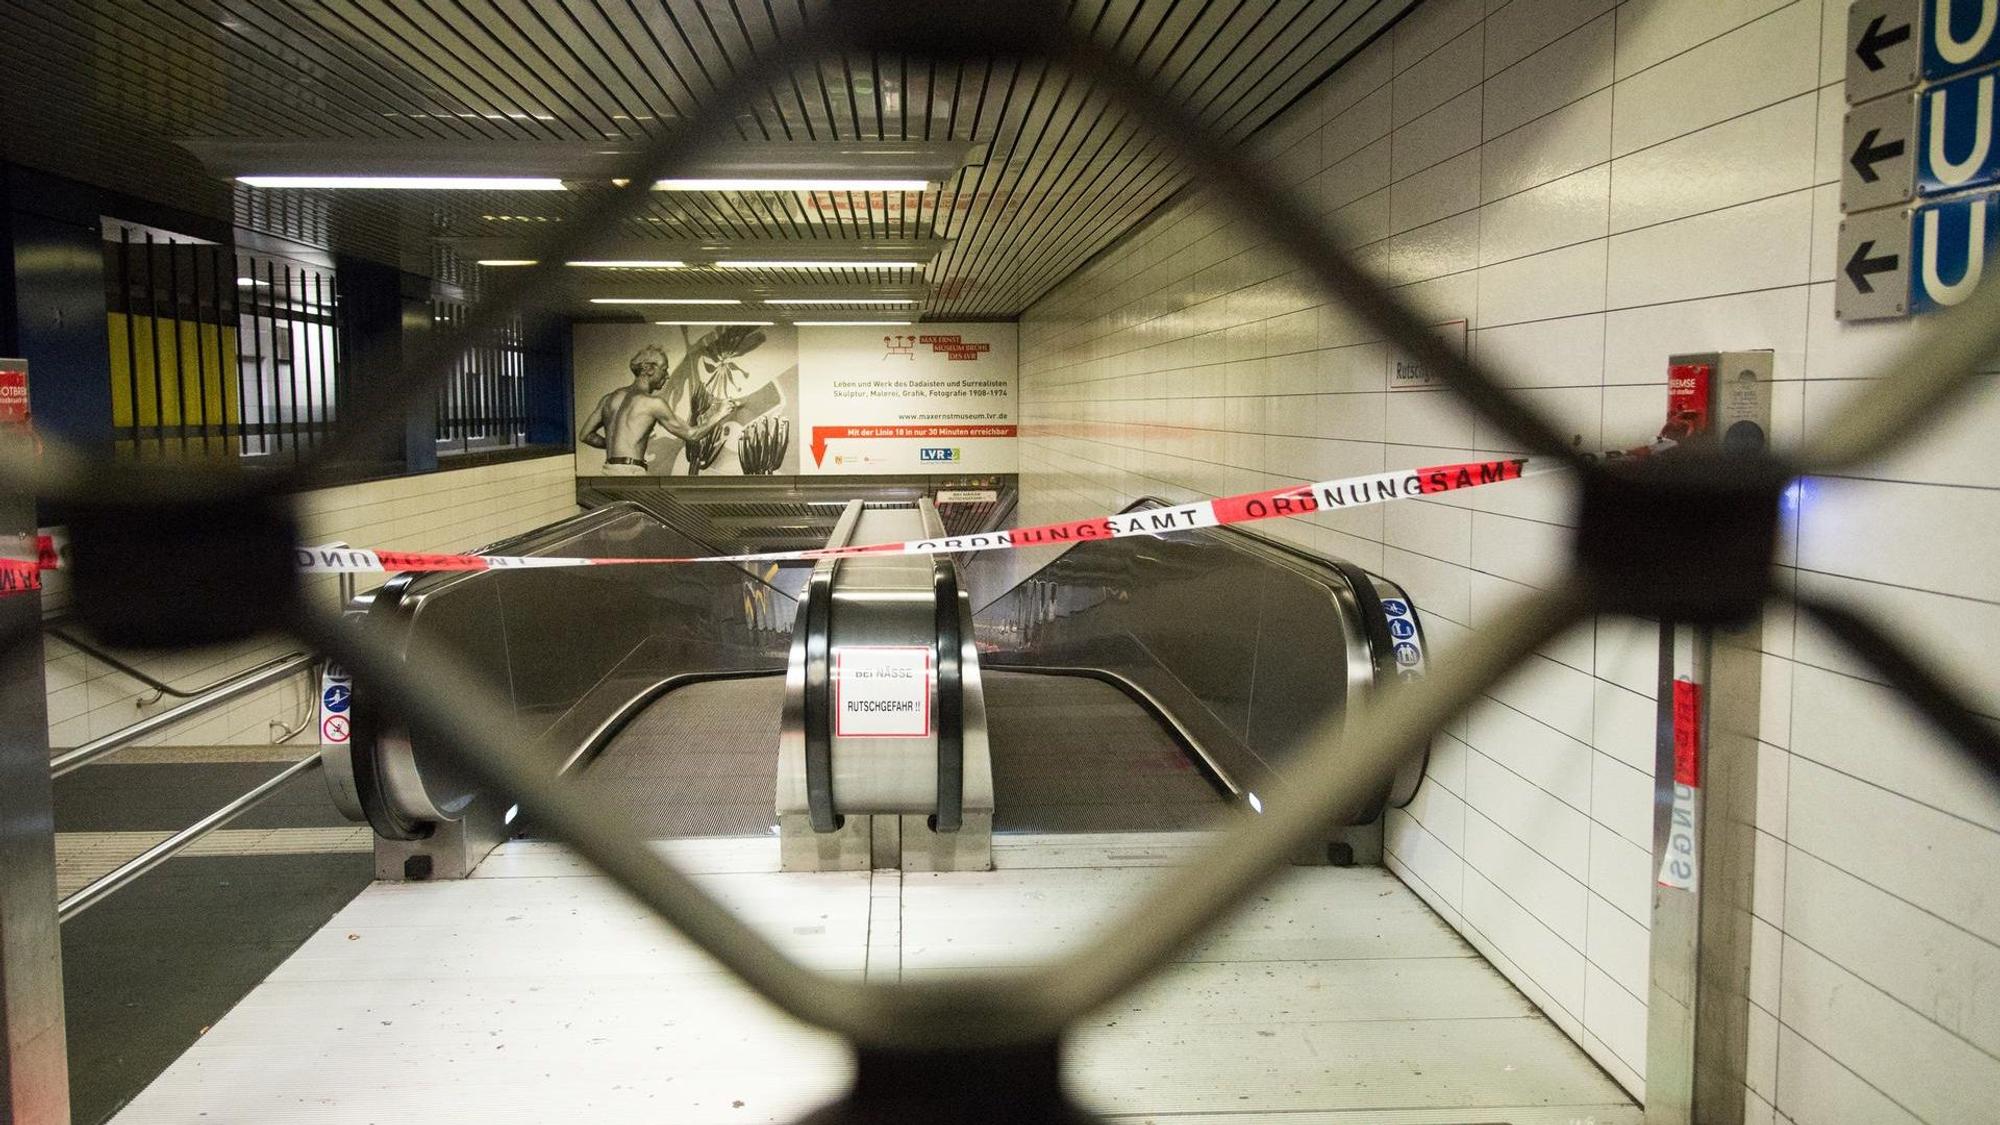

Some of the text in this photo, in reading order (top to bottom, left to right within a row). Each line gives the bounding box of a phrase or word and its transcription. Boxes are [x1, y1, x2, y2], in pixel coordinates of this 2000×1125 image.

[1935, 0, 1998, 64] U
[1929, 75, 1994, 185] U
[1922, 200, 1986, 306] U
[873, 380, 892, 388] Werk
[930, 390, 967, 398] Fotografie
[928, 428, 938, 436] 30
[970, 428, 1008, 436] erreichbar
[922, 450, 945, 460] LVR
[1246, 459, 1529, 518] ORDNUNGSAMT
[847, 700, 914, 712] RUTSCHGEFAHR
